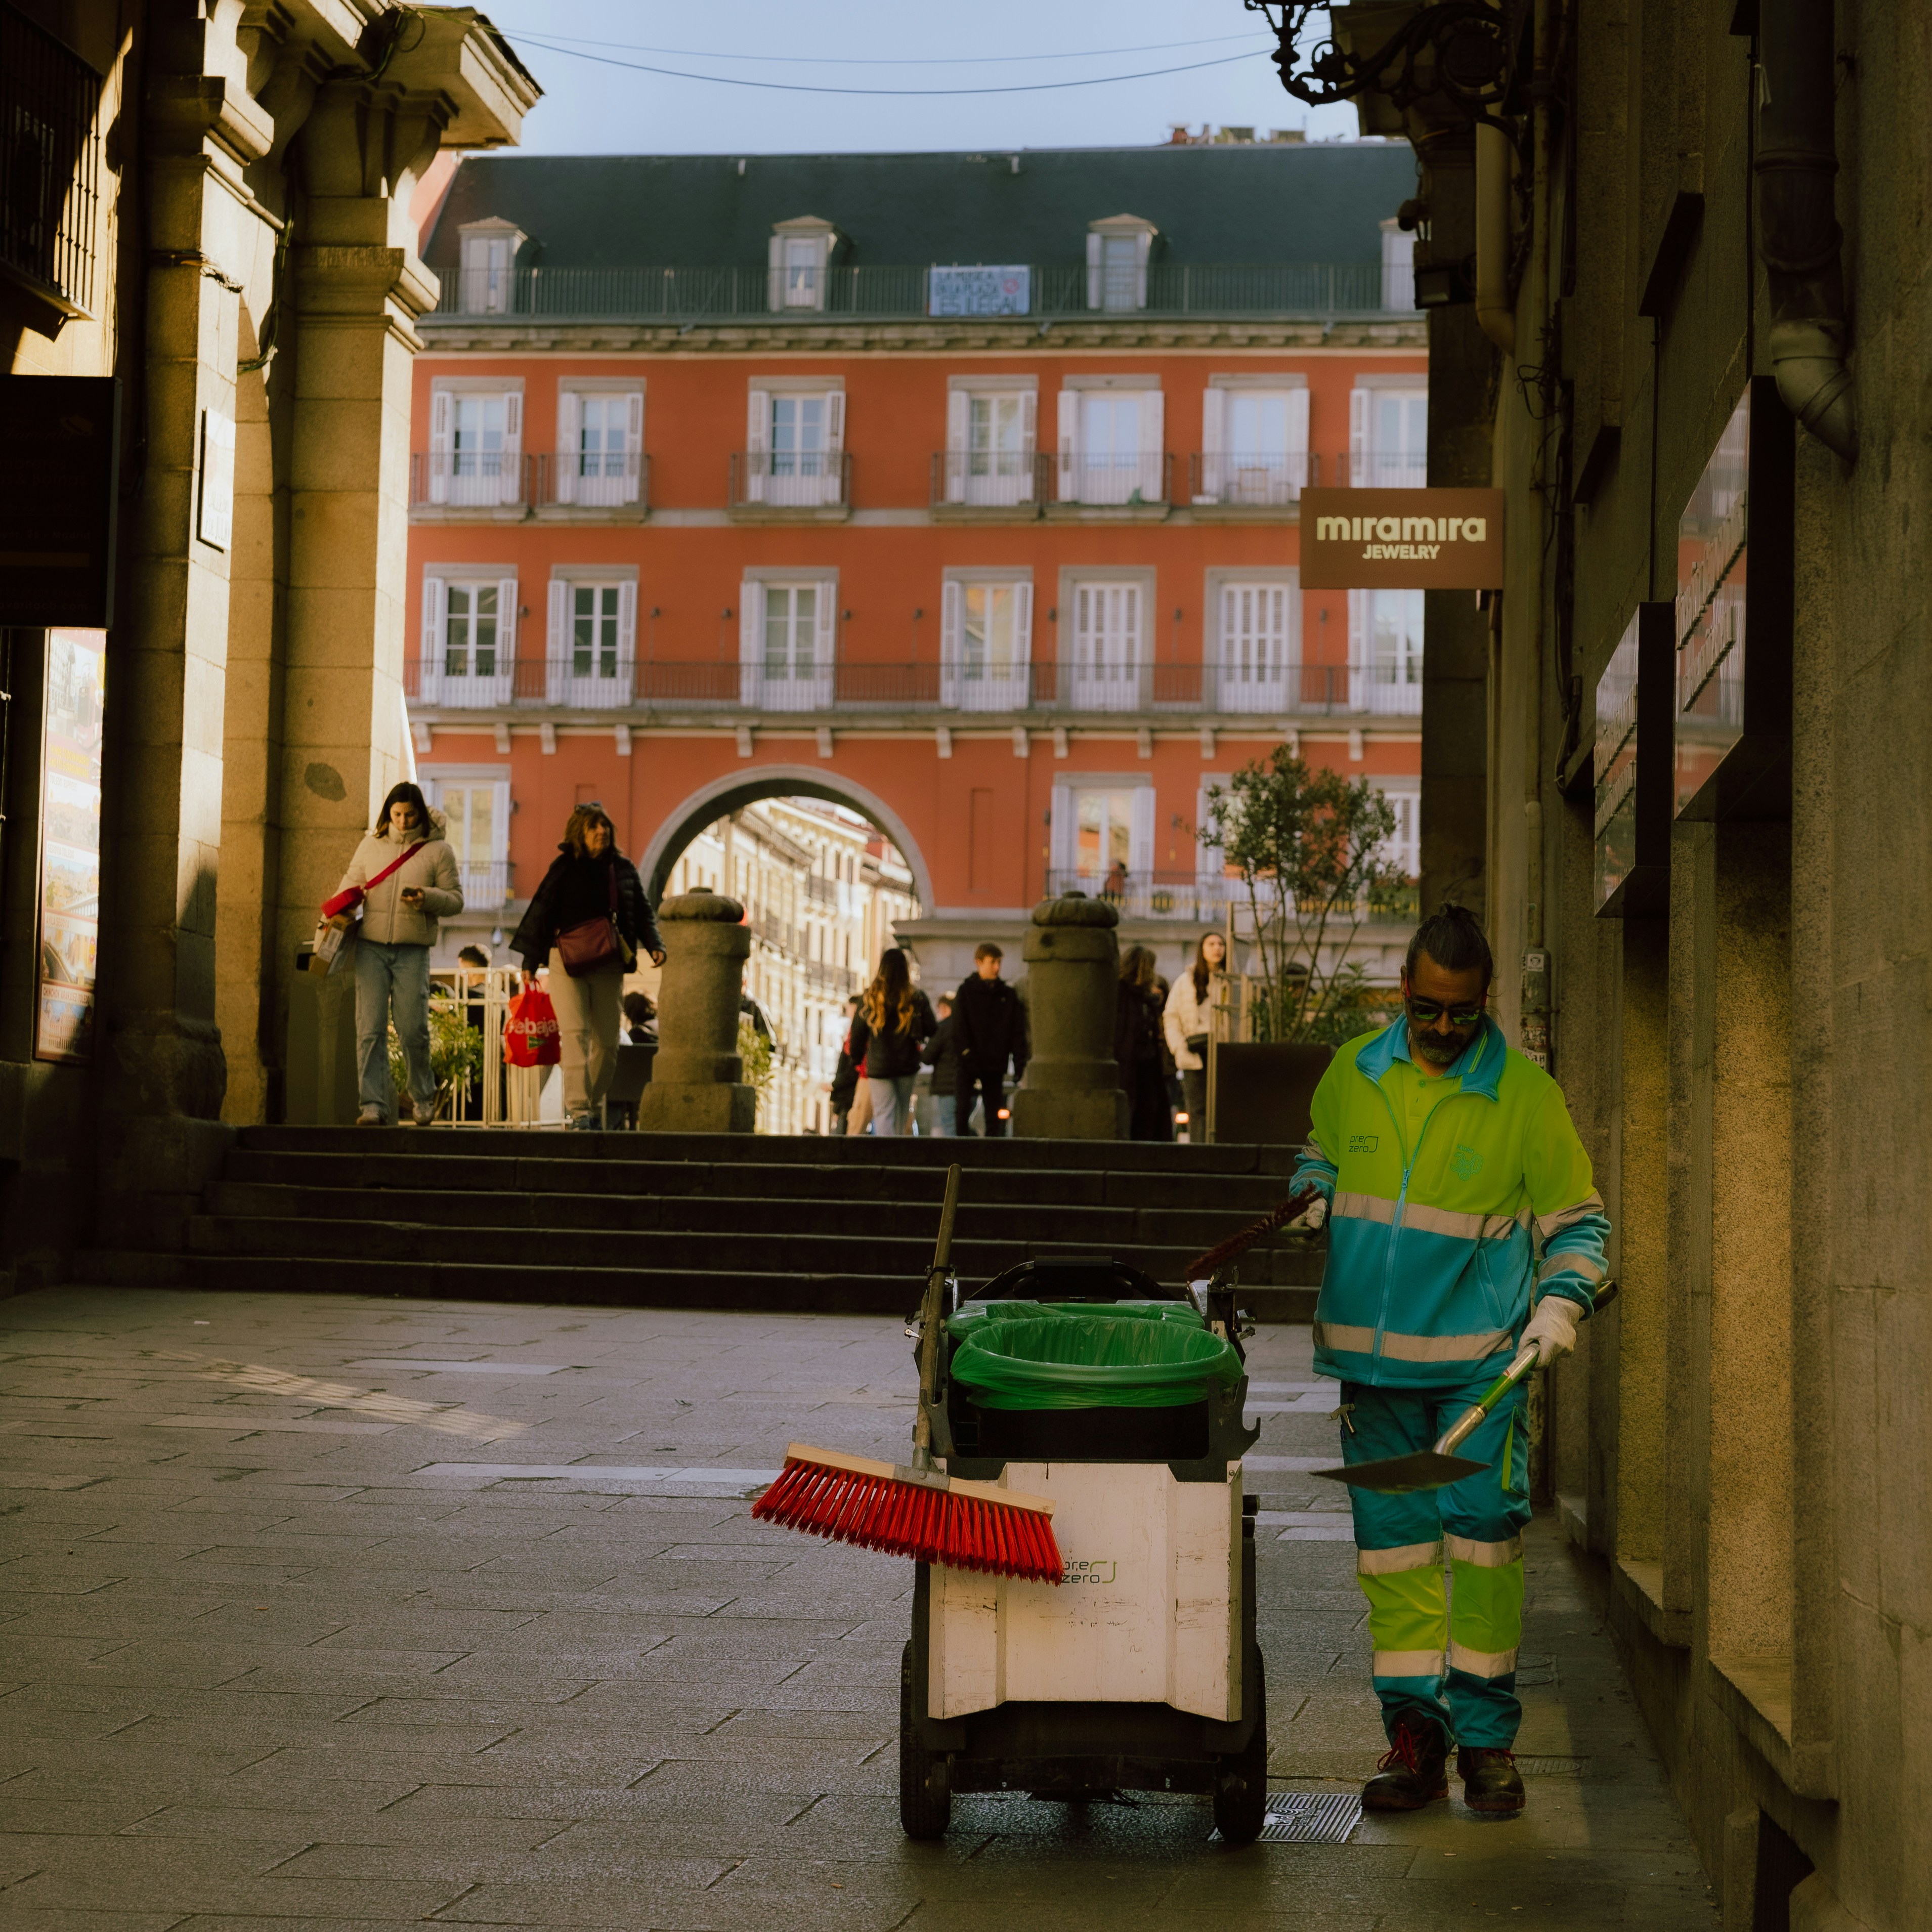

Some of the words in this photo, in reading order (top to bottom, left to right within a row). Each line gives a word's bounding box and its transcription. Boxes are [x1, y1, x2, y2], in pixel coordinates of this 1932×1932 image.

[1317, 517, 1486, 542] miramira
[1362, 544, 1441, 560] JEWELRY
[1350, 1136, 1364, 1144] pre
[1061, 1574, 1100, 1583] zero
